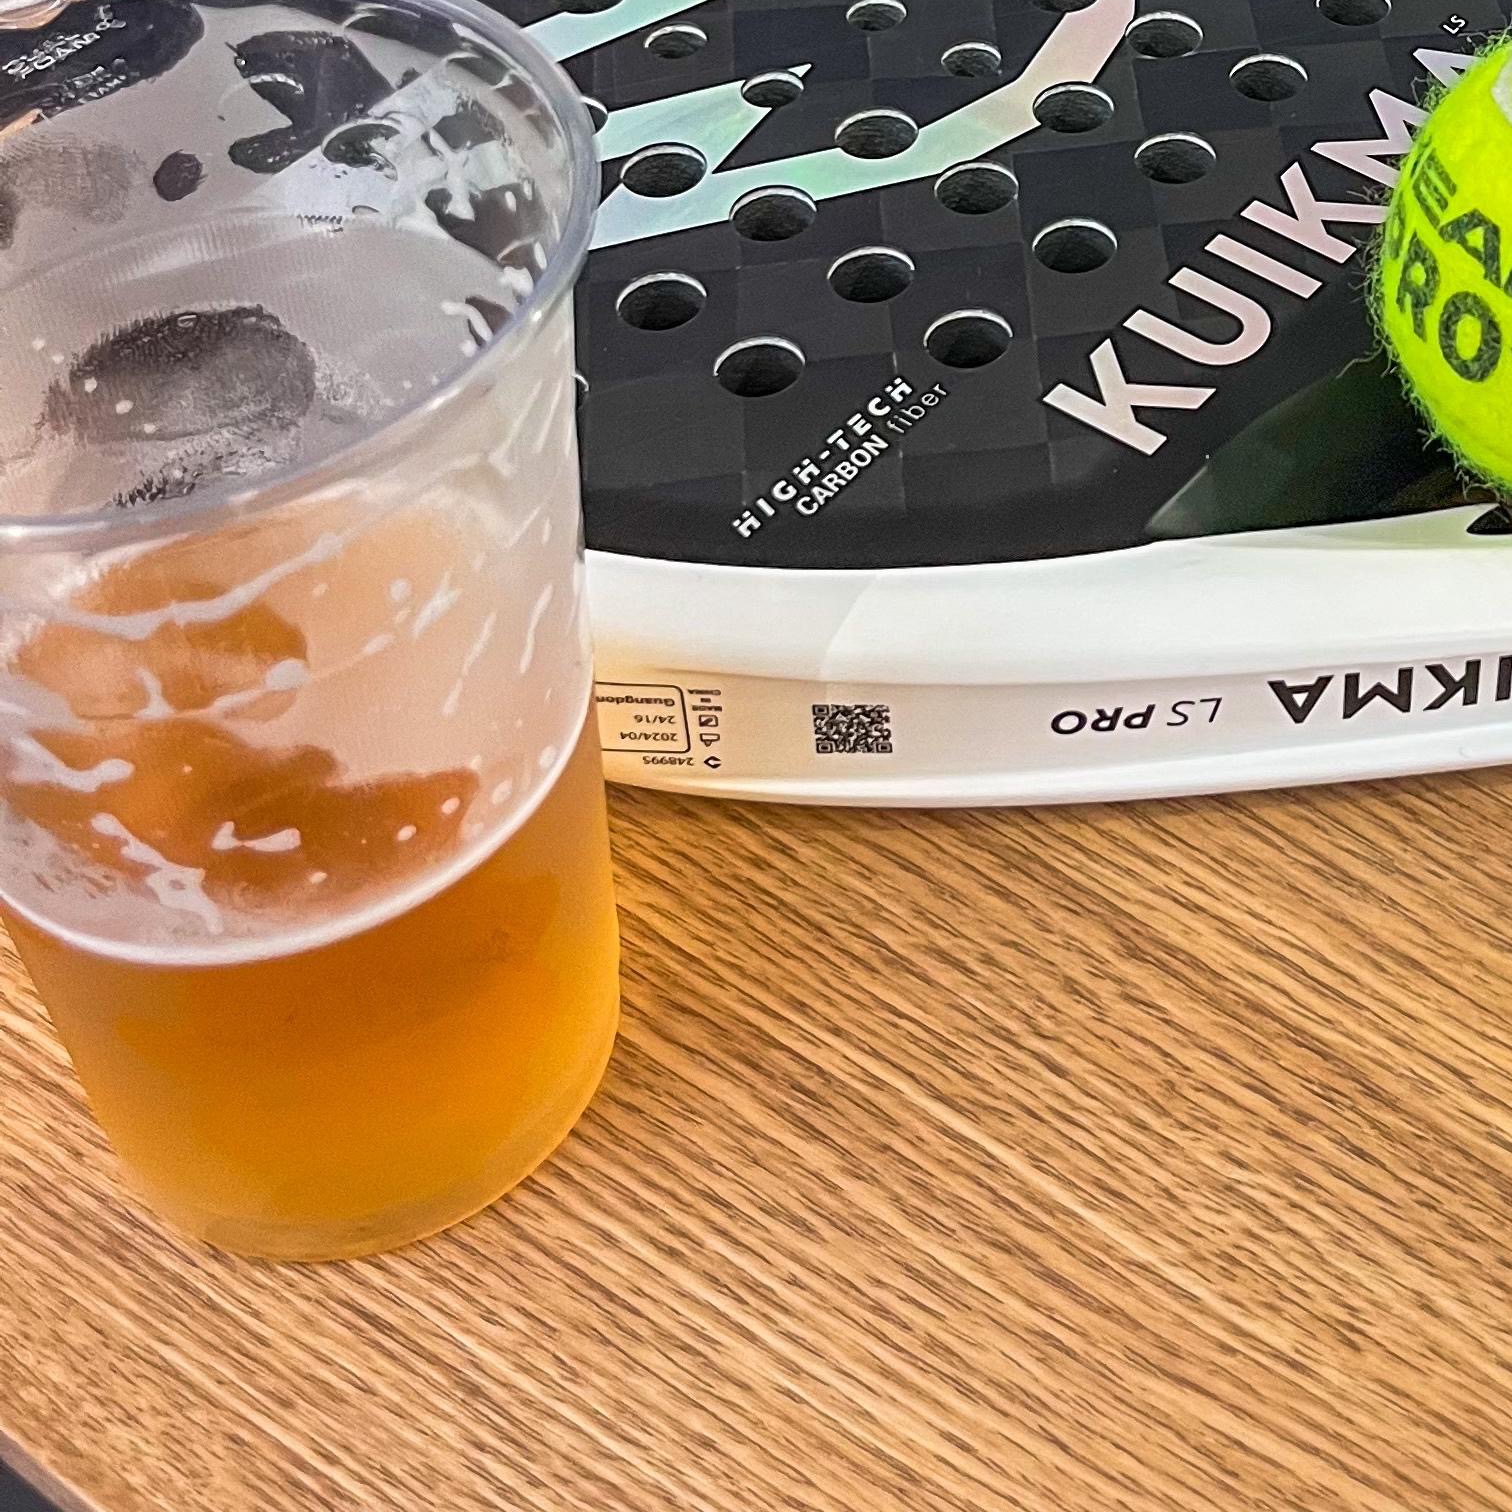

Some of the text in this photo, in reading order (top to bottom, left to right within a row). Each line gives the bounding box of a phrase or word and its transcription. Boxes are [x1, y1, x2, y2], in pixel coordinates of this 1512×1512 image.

[1443, 14, 1466, 35] LS
[732, 376, 913, 539] HIGH-TECH
[795, 383, 947, 516] CARBON fiber
[595, 695, 675, 707] Guangdon
[634, 714, 676, 724] 24/16
[1051, 705, 1156, 735] PRO
[1166, 696, 1223, 728] LS
[620, 731, 678, 742] 2024/04
[642, 755, 694, 766] 248995
